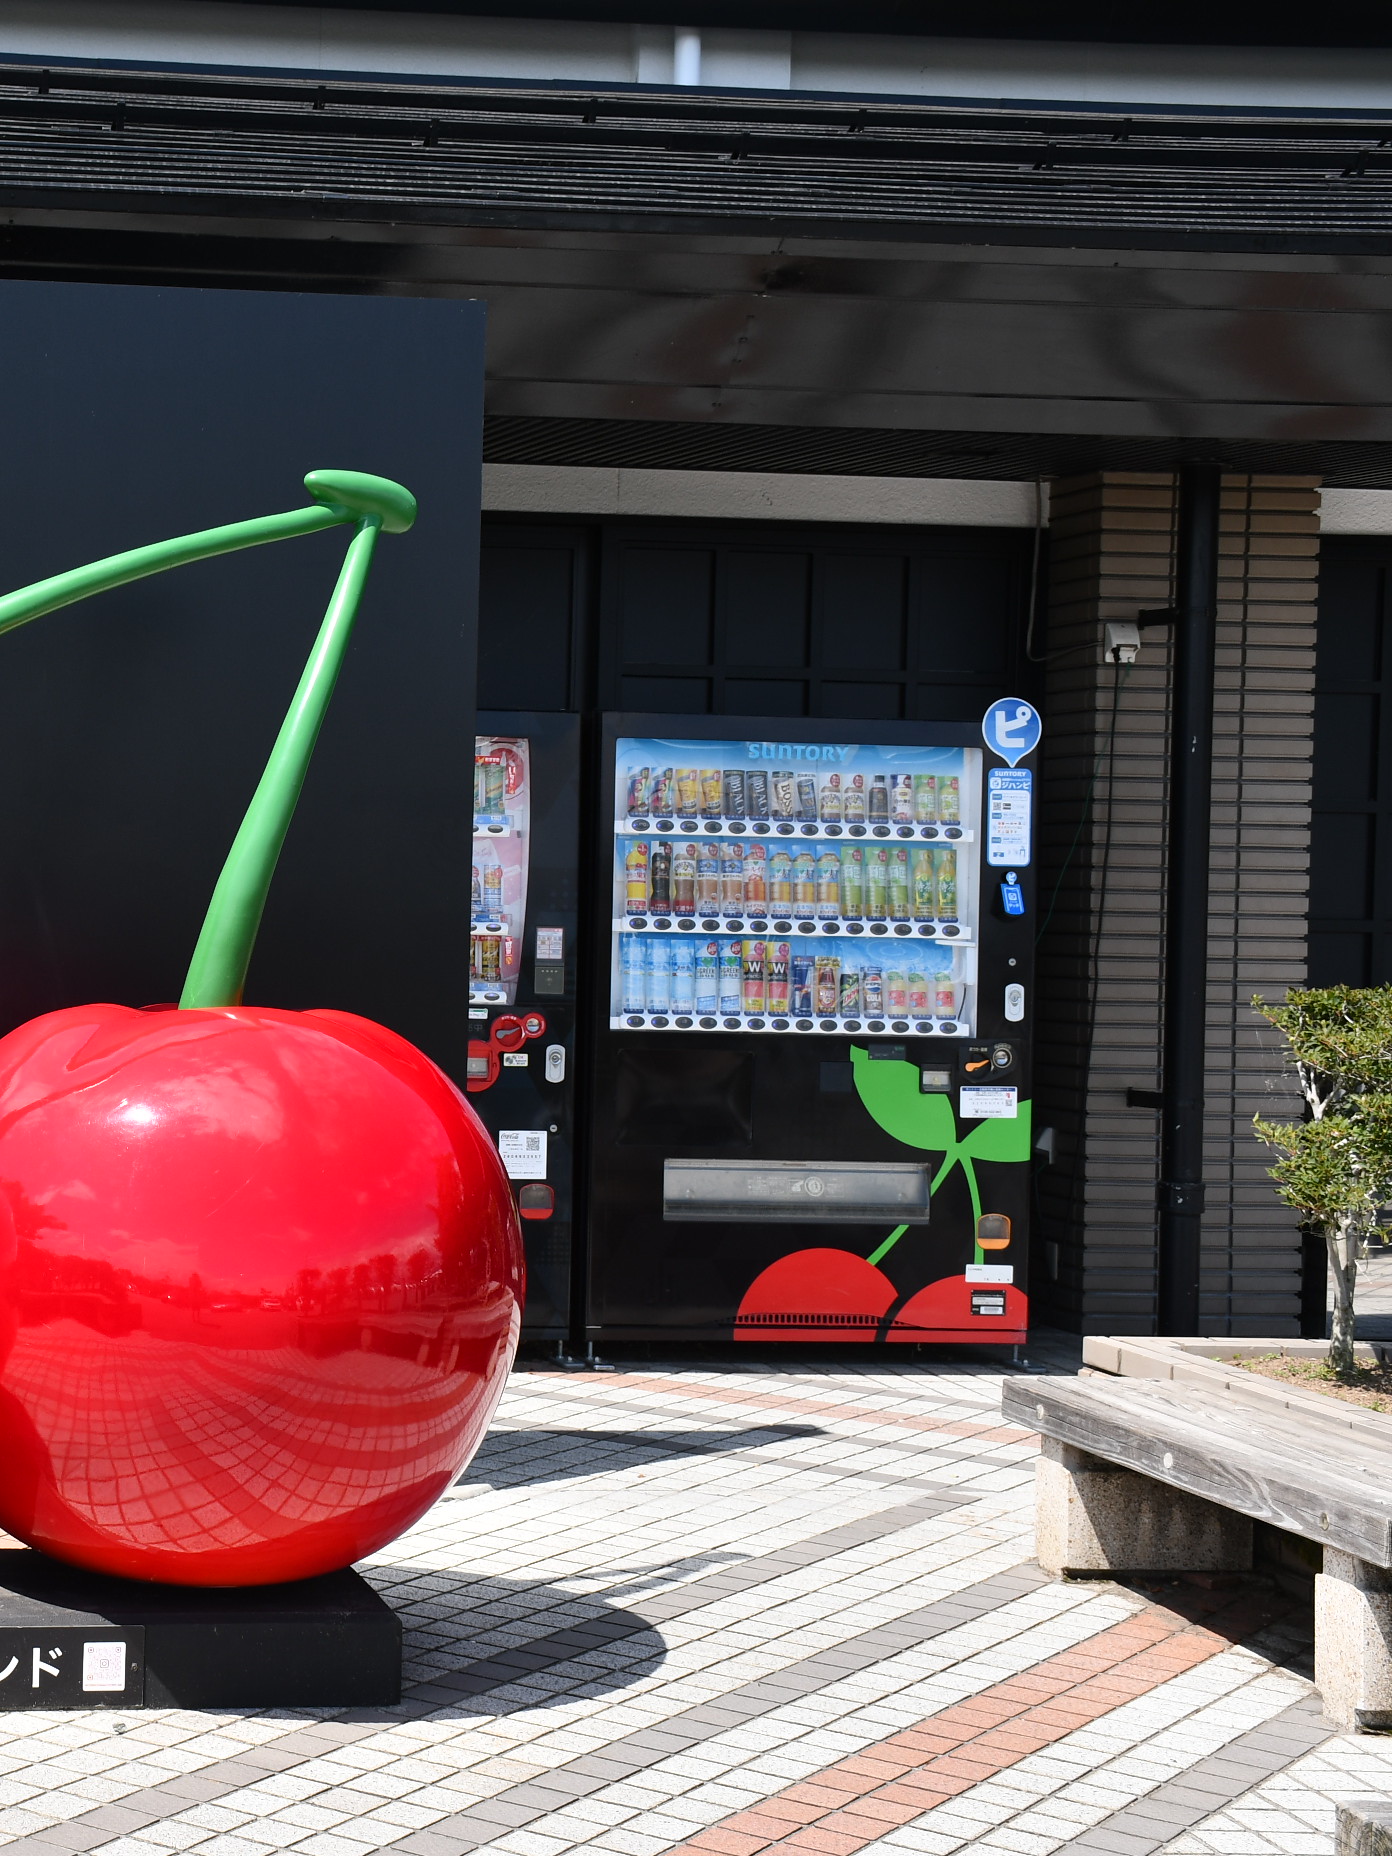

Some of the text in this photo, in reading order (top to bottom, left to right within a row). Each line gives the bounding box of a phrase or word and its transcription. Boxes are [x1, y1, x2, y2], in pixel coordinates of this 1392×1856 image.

[995, 706, 1031, 748] ピ
[781, 784, 793, 815] BOSS
[748, 961, 761, 972] W
[772, 962, 785, 974] W
